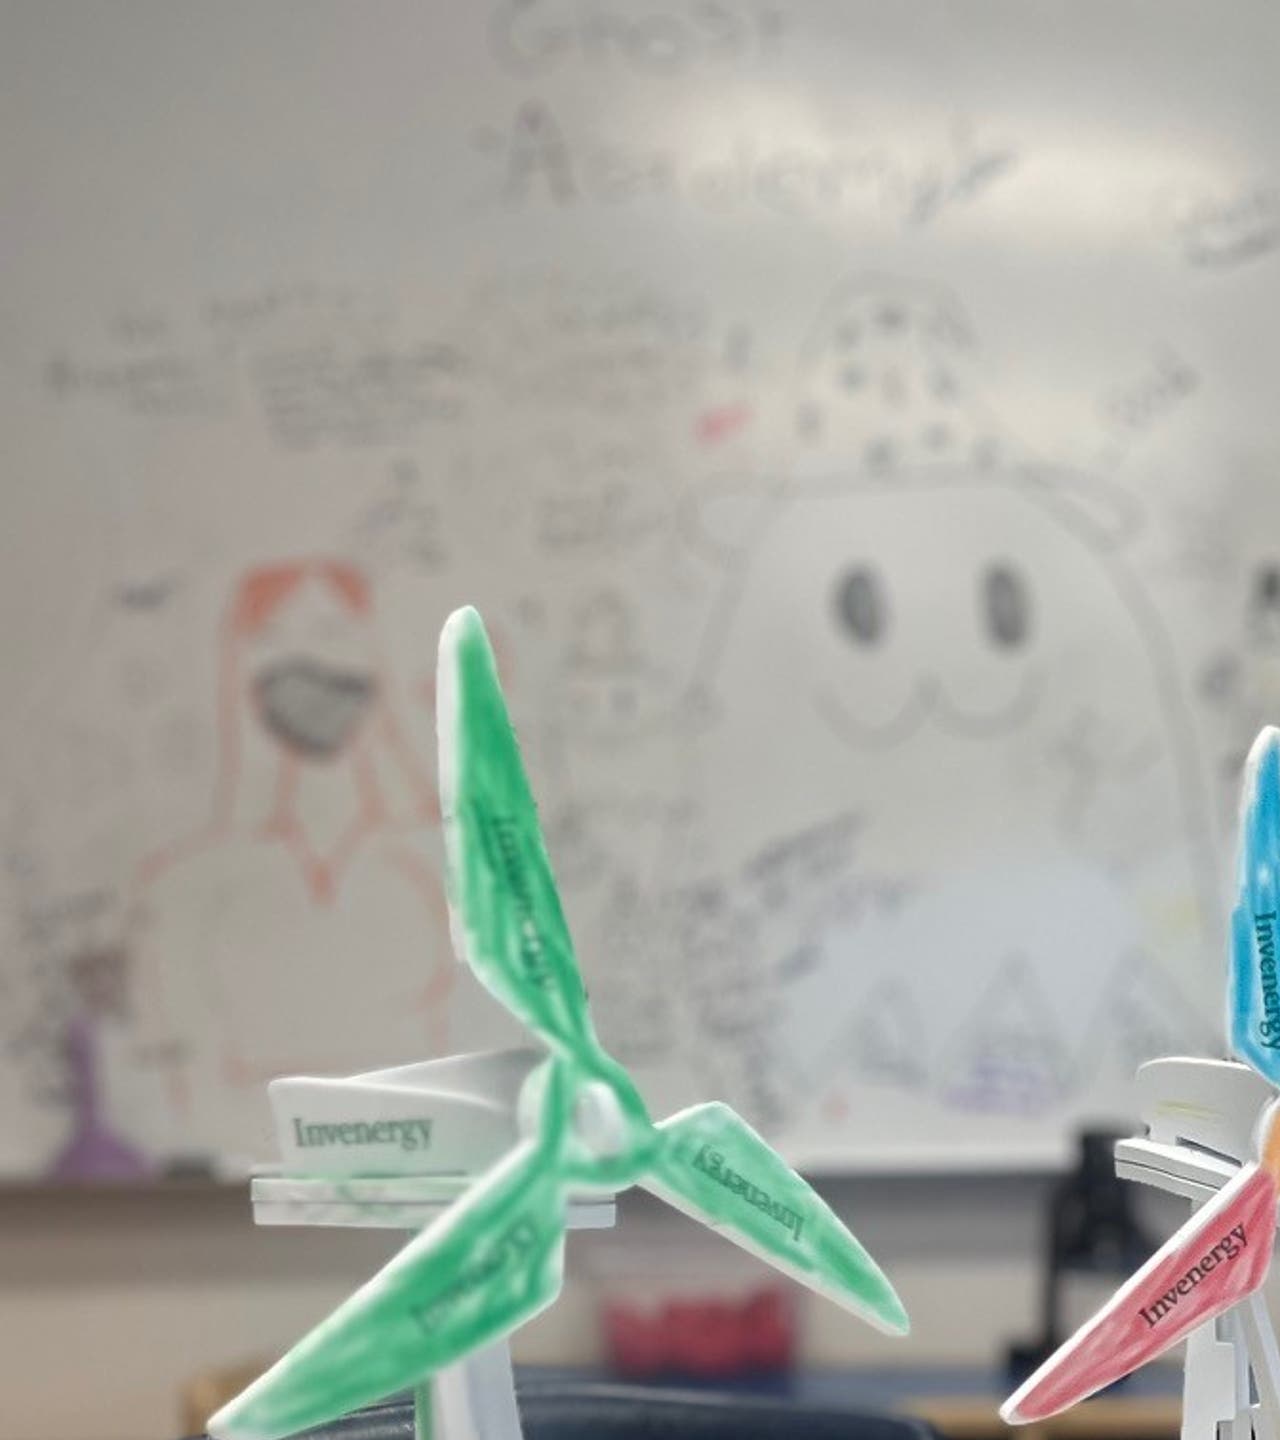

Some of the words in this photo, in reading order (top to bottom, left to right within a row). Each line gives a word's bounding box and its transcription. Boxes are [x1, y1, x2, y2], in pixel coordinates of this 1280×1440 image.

[293, 1117, 434, 1152] Invenergy
[692, 1143, 806, 1242] Invenergy
[1138, 1220, 1248, 1328] Invenergy
